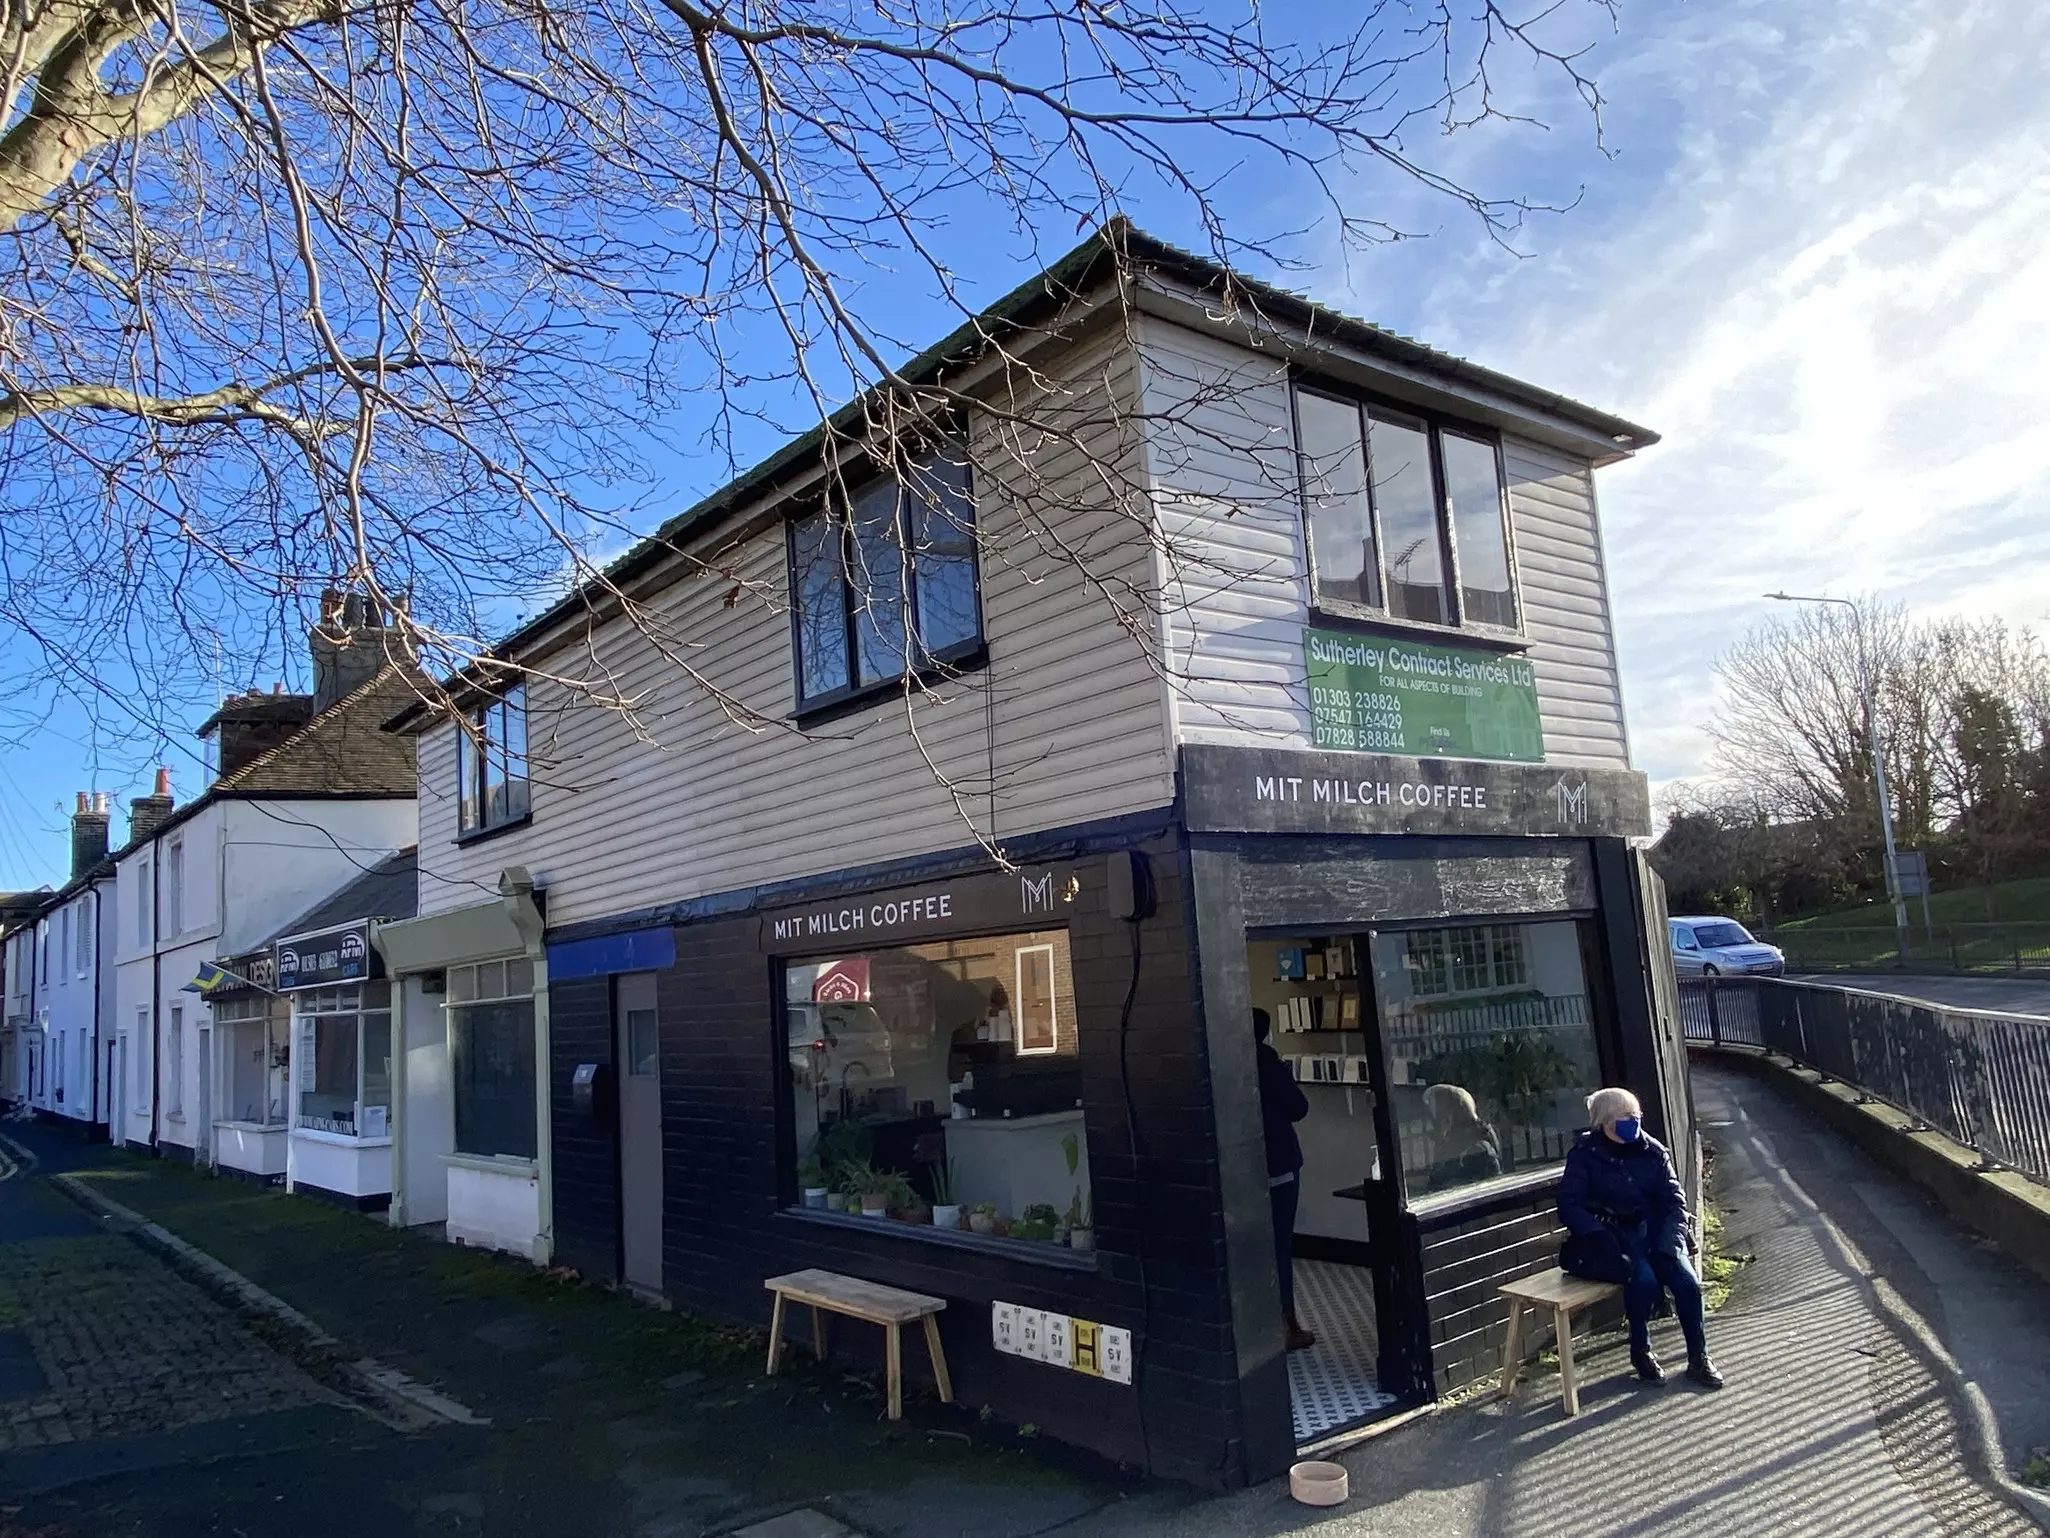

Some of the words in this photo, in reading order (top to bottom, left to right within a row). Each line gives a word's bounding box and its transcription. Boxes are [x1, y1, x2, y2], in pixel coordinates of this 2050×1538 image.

[1311, 637, 1384, 673] Sutherley
[1388, 647, 1453, 678] Contract
[1454, 656, 1509, 684] Services
[1511, 664, 1531, 687] Ltd
[1313, 687, 1351, 707] 01303
[1355, 692, 1401, 711] 238826
[1380, 675, 1395, 688] FOR
[1397, 677, 1409, 690] ALL
[1410, 680, 1440, 693] ASPECTS
[1440, 683, 1450, 694] OF
[1452, 684, 1483, 697] BUILDING
[1315, 706, 1352, 725] 07547
[1357, 711, 1402, 730] 164429
[1316, 727, 1355, 746] 07828
[1359, 730, 1405, 748] 588844
[1256, 776, 1302, 801] MIT
[1313, 779, 1390, 805] MILCH
[1399, 783, 1486, 809] COFFEE
[774, 917, 803, 940] MIT
[808, 908, 864, 935] MILCH
[870, 895, 952, 927] COFFEE
[1075, 1324, 1097, 1370] H
